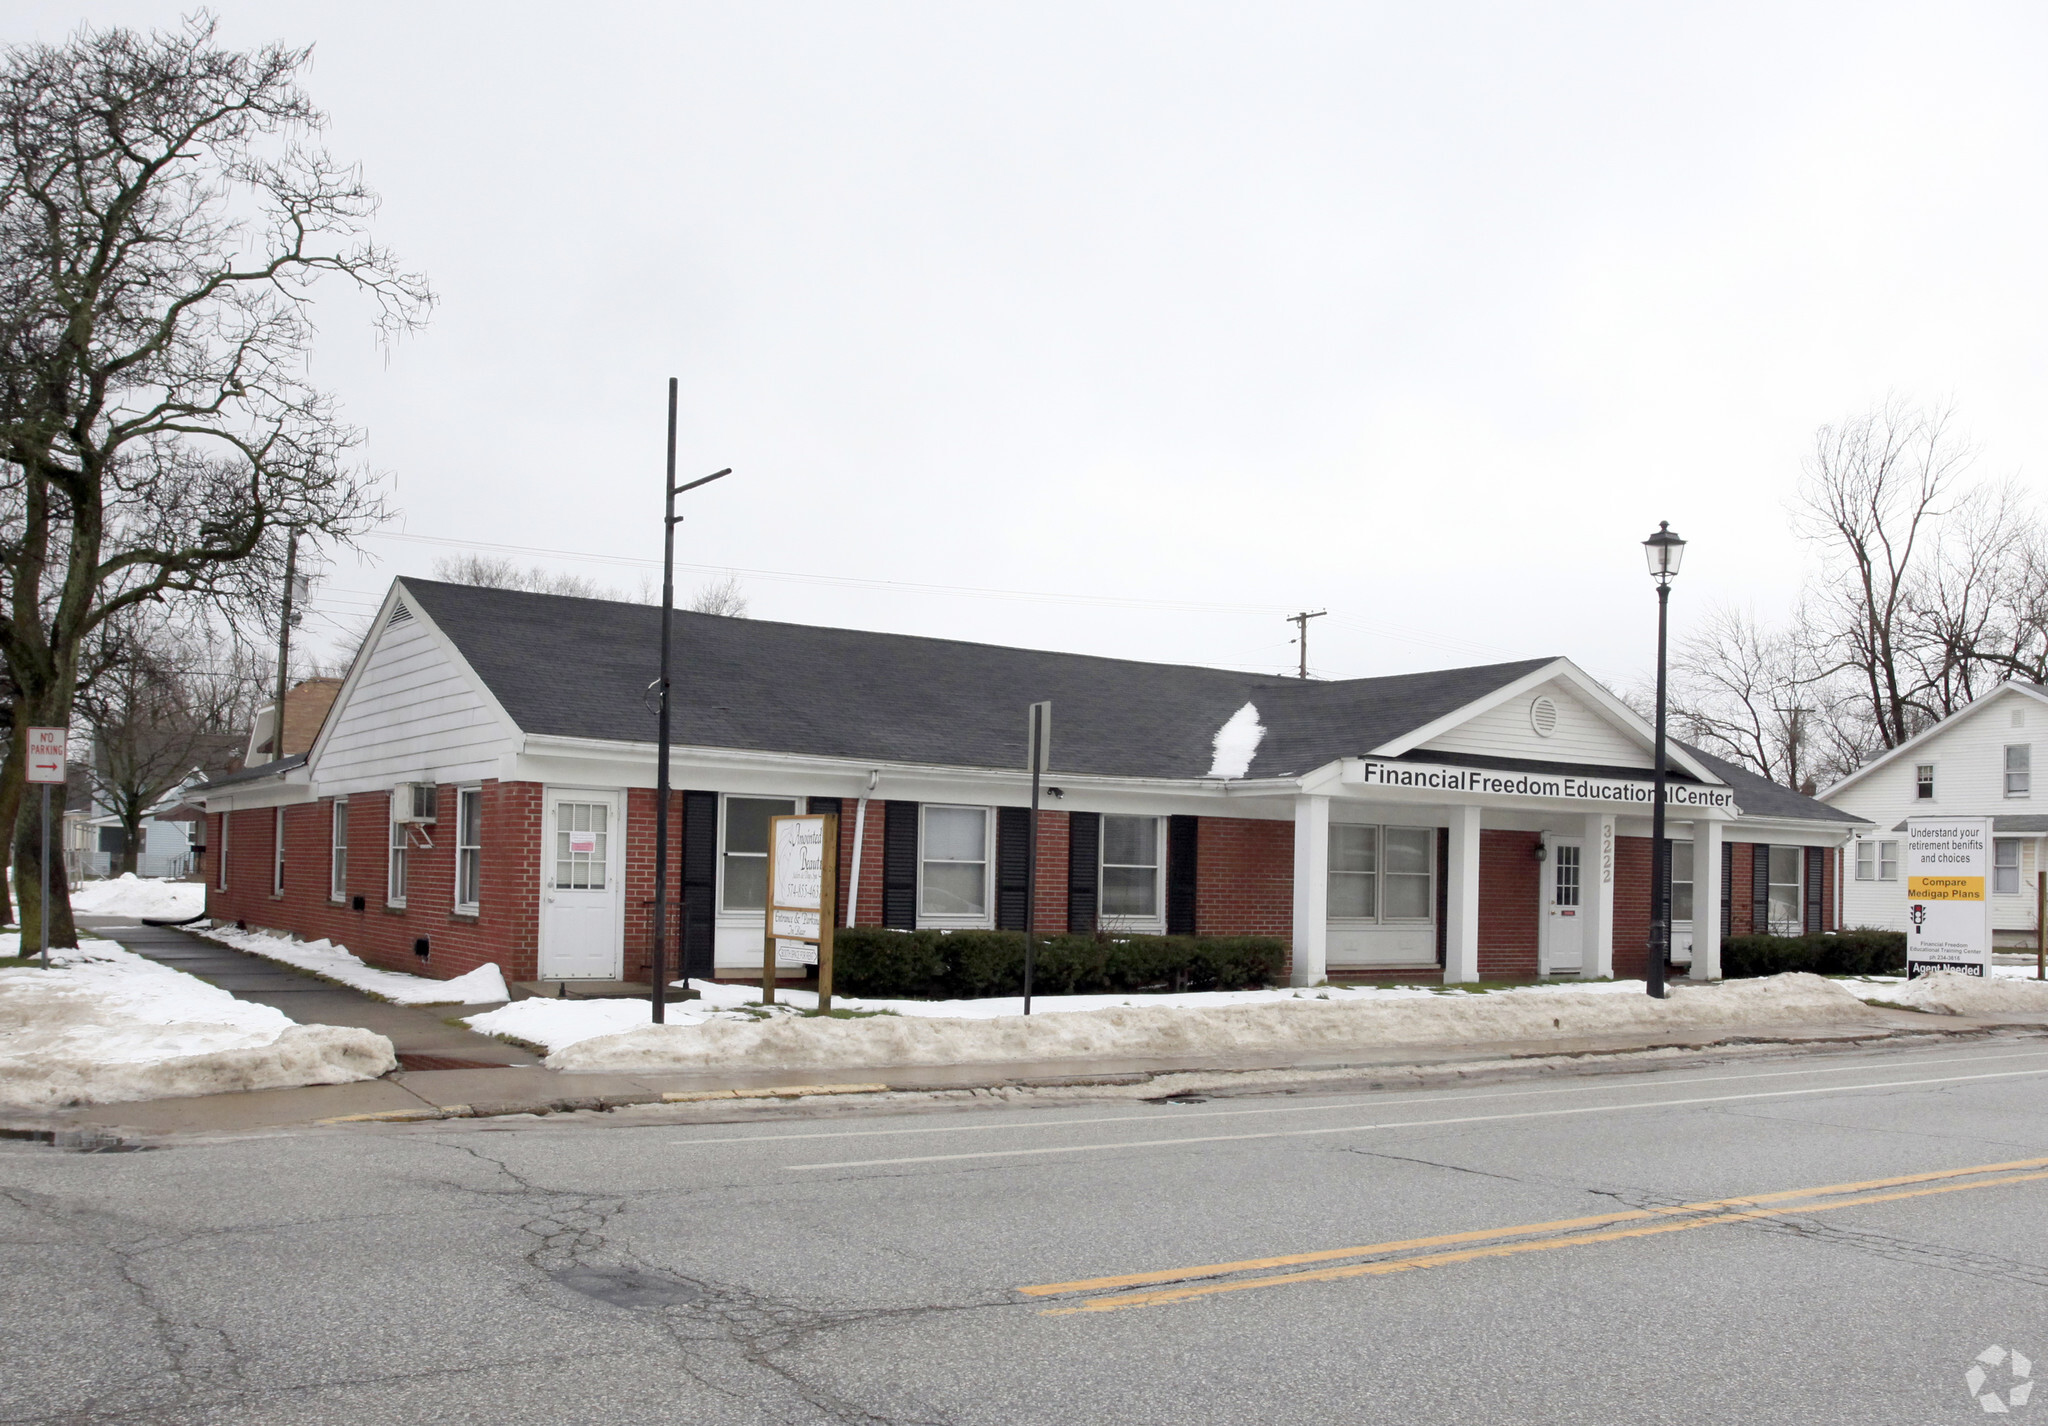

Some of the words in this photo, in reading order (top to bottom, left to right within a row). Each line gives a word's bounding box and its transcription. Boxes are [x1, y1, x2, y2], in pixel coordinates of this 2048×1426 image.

[41, 732, 54, 743] NO
[31, 744, 63, 756] PARKING
[1364, 762, 1466, 790] Financial
[1469, 772, 1560, 797] Freedom
[1675, 786, 1732, 807] Center
[789, 822, 822, 847] Anointed
[1910, 827, 1958, 838] Understand
[1959, 829, 1980, 840] your
[1908, 840, 1950, 850] retirement
[1952, 839, 1984, 850] benifits
[1602, 824, 1612, 883] 3222
[1920, 853, 1936, 863] and
[1938, 853, 1971, 863] choices
[1922, 877, 1967, 888] Compare
[787, 883, 821, 898] 574-855-463
[1908, 889, 1949, 900] Medigap
[1952, 889, 1980, 899] Plans
[802, 911, 819, 926] Parkin
[1913, 963, 1940, 975] Agent
